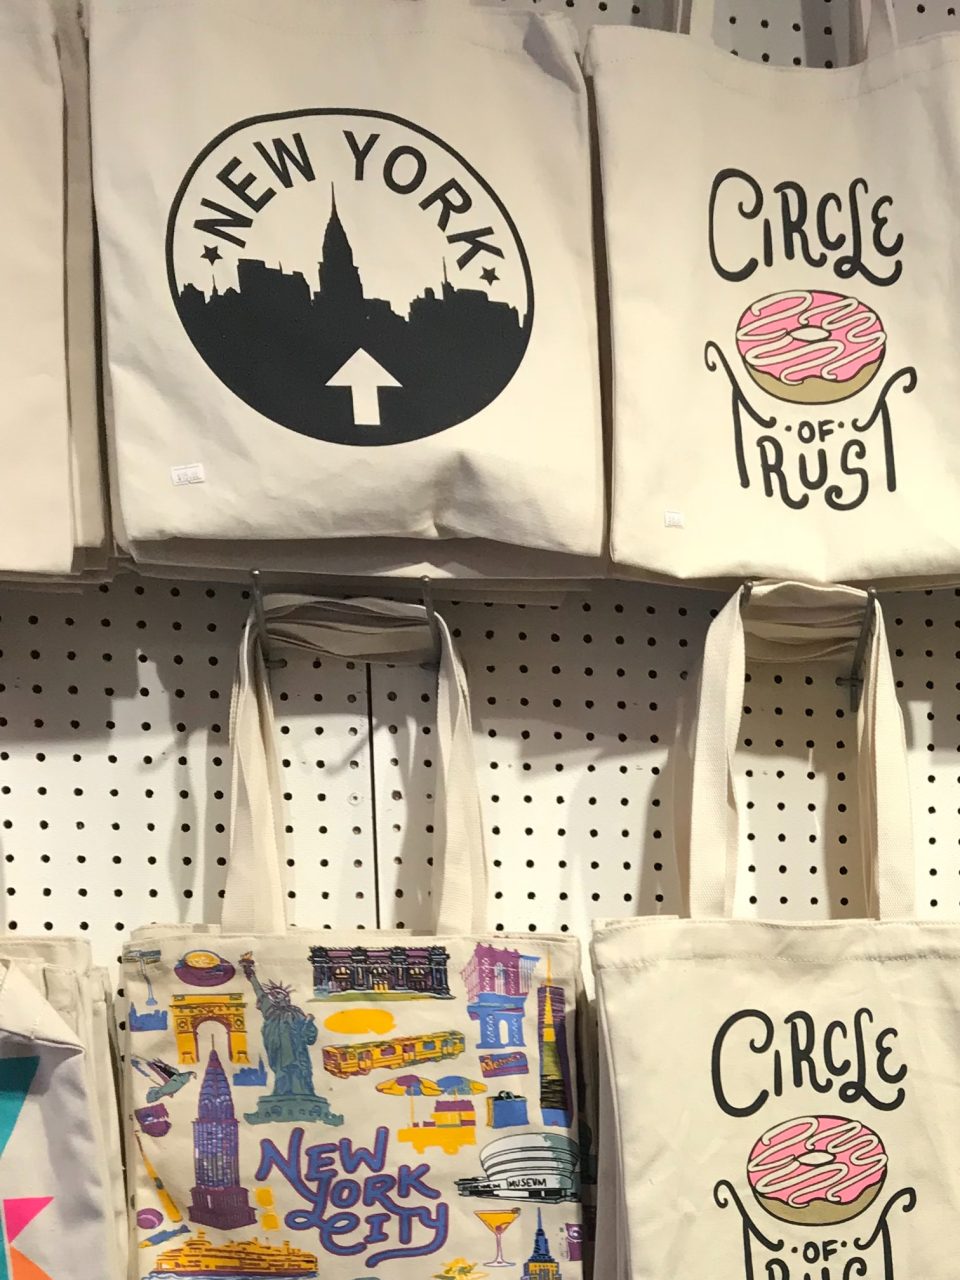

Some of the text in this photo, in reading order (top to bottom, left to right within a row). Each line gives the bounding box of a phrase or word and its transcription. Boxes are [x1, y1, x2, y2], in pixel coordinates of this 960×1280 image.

[193, 129, 505, 271] NEW YORK
[704, 340, 917, 511] TRUST
[797, 419, 835, 444] OF
[255, 1126, 389, 1203] NEW
[284, 1163, 442, 1230] YORK
[319, 1202, 449, 1268] CITY
[802, 1239, 839, 1264] OF
